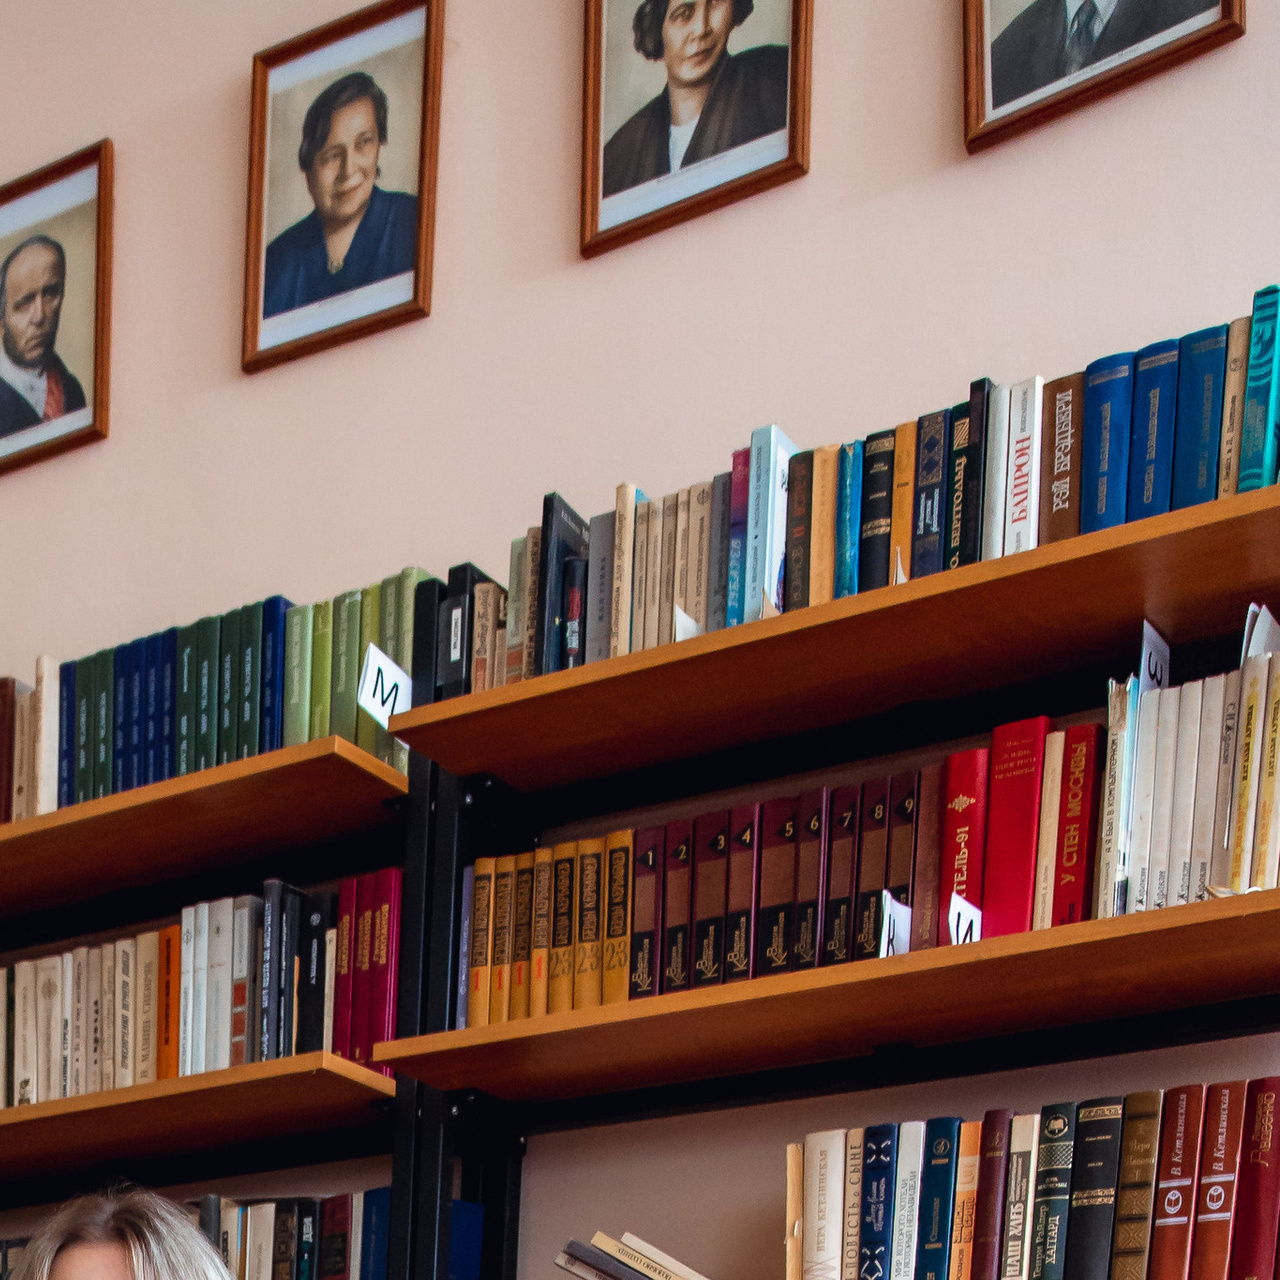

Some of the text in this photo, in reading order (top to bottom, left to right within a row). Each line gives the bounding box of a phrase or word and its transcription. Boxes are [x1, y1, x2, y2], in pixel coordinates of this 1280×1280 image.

[1052, 389, 1074, 512] РЭЙ БРЭДБЕРИ
[1010, 435, 1031, 525] БАЙРОН
[373, 666, 397, 714] М
[784, 821, 794, 837] 5
[810, 814, 819, 831] 6
[842, 811, 852, 828] 7
[874, 804, 883, 820] 8
[904, 798, 913, 814] 9
[1061, 742, 1086, 885] У СТЕН МОСКВЫ
[646, 850, 654, 866] 1
[678, 843, 687, 860] 2
[718, 835, 725, 850] 3
[741, 827, 752, 844] 4
[380, 904, 389, 964] БАКЛАНОВ
[1172, 1093, 1187, 1162] Кетлинская
[1213, 1089, 1230, 1158] Кетлинская
[849, 1143, 861, 1185] СЫНЕ
[816, 1149, 828, 1252] ВЕРА КЕТЛИНСКАЯ
[846, 1203, 859, 1269] ПОВЕСТЬ
[1006, 1202, 1025, 1276] НАШ ХЛЕБ
[1032, 1205, 1049, 1278] Генри Райдер
[1045, 1215, 1060, 1264] ХАГГАРД
